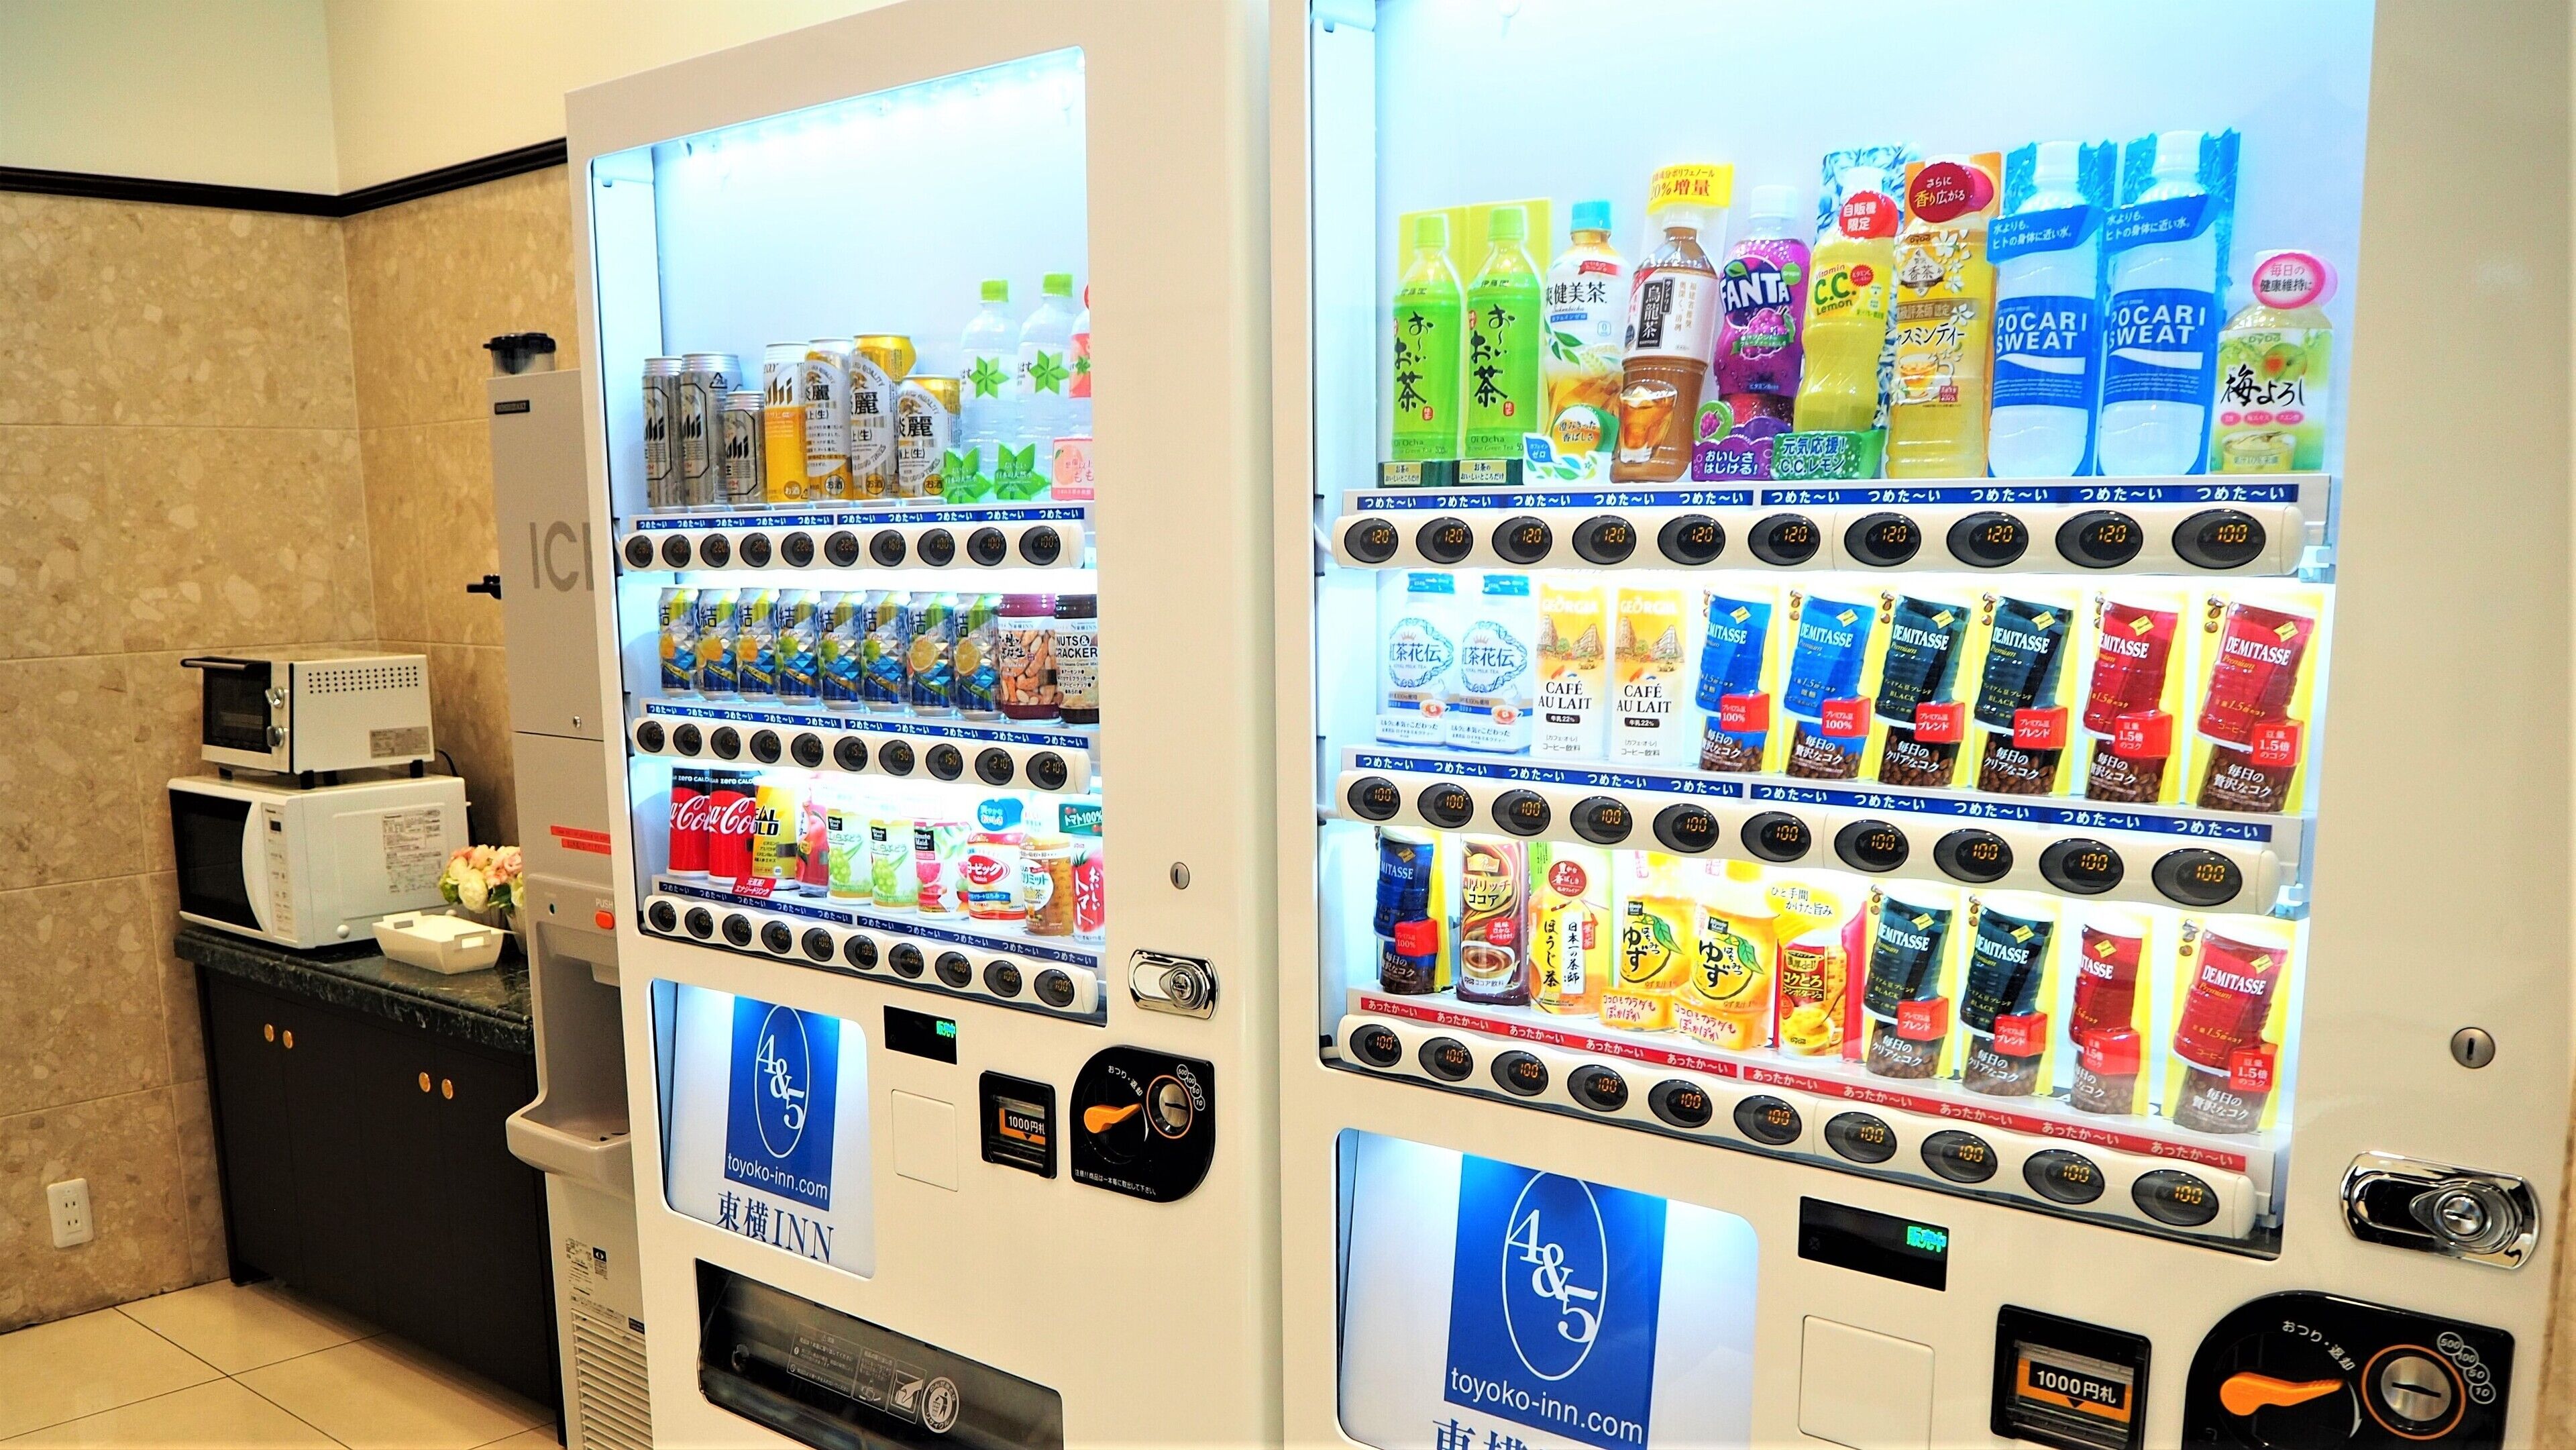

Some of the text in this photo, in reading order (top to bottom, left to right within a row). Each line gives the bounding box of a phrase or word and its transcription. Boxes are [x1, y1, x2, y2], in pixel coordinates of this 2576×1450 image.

[1927, 178, 1952, 189] さらに
[1915, 190, 1966, 209] 香り広がる
[1843, 201, 1876, 217] 自販機
[1847, 217, 1871, 231] 限定
[2260, 278, 2312, 292] 健康維持に
[1817, 299, 1853, 315] Lemon
[1997, 311, 2087, 333] POCARI
[2110, 304, 2206, 327] POCARI
[1996, 331, 2078, 352] SWEAT
[2108, 325, 2196, 350] SWEAT
[2220, 364, 2305, 407] 梅よろし
[1482, 435, 1504, 444] Ocha
[1532, 451, 1546, 459] ゼロ
[1706, 451, 1754, 462] おいしさ
[1605, 527, 1625, 542] 120
[1693, 527, 1713, 542] 120
[1785, 526, 1807, 541] 120
[1884, 526, 1907, 542] 120
[1988, 525, 2013, 542] 120
[2099, 525, 2126, 542] 120
[2218, 525, 2247, 542] 100
[1800, 623, 1854, 648] DEMITASSE
[1893, 625, 1949, 651] DEMITASSE
[1993, 626, 2050, 654] DEMITASSE
[2225, 636, 2292, 666] DEMITASSE
[2222, 654, 2256, 670] Premium
[1546, 681, 1583, 695] CAFÉ
[1624, 684, 1662, 698] CAFÉ
[1890, 690, 1916, 702] BLACK
[1538, 696, 1592, 709] AU LAIT
[1617, 700, 1671, 713] AU LAIT
[1722, 713, 1746, 723] 100%
[1825, 719, 1852, 729] 100%
[2019, 728, 2050, 737] ブレンド
[1805, 735, 1835, 752] 毎日の
[2259, 740, 2290, 752] 1.5倍
[1621, 748, 1660, 756] コーヒー飲料
[1795, 744, 1843, 764] 贅沢なコク
[1996, 747, 2029, 764] 毎日の
[2260, 750, 2287, 760] のコク
[1886, 750, 1939, 772] クリアなコク
[1984, 757, 2039, 780] クリアなコク
[2228, 764, 2265, 783] 毎日の
[2214, 773, 2272, 798] 贅沢なコク
[1375, 788, 1391, 802] 100
[1522, 802, 1540, 816] 100
[1686, 817, 1707, 832] 100
[1872, 834, 1895, 850] 100
[2082, 853, 2108, 871] 100
[1468, 893, 1499, 907] ココア
[1770, 886, 1809, 902] ひと手間
[596, 898, 613, 908] PUSH
[1544, 920, 1560, 988] ほうじ茶
[1623, 927, 1648, 972] ゆず
[1699, 939, 1730, 988] ゆず
[1004, 972, 1017, 982] 100
[1783, 972, 1823, 988] コクとろ
[2201, 965, 2267, 996] DEMITASSE
[1055, 981, 1068, 991] 100
[1377, 1035, 1393, 1049] 100
[1882, 1035, 1913, 1053] 毎日の
[1978, 1049, 2008, 1069] 毎日の
[1521, 1063, 1538, 1078] 100
[1968, 1056, 2019, 1083] クリアなコク
[2237, 1066, 2268, 1080] 1.5倍
[757, 1034, 805, 1130] 4&5
[1681, 1094, 1701, 1108] 100
[2206, 1088, 2243, 1107] 毎日の
[1008, 1115, 1045, 1136] 1000円札
[1860, 1126, 1884, 1143] 100
[727, 1152, 828, 1202] toyoko-inn.com
[2064, 1164, 2090, 1182] 100
[716, 1191, 834, 1264] 東横INN
[1508, 1208, 1599, 1343] 4&5
[2440, 1337, 2461, 1349] 500
[2457, 1352, 2476, 1364] 100
[2469, 1368, 2486, 1379] 50
[2037, 1369, 2116, 1404] 1000円札
[2475, 1386, 2490, 1398] 10
[1451, 1366, 1644, 1445] toyoko-inn.com
